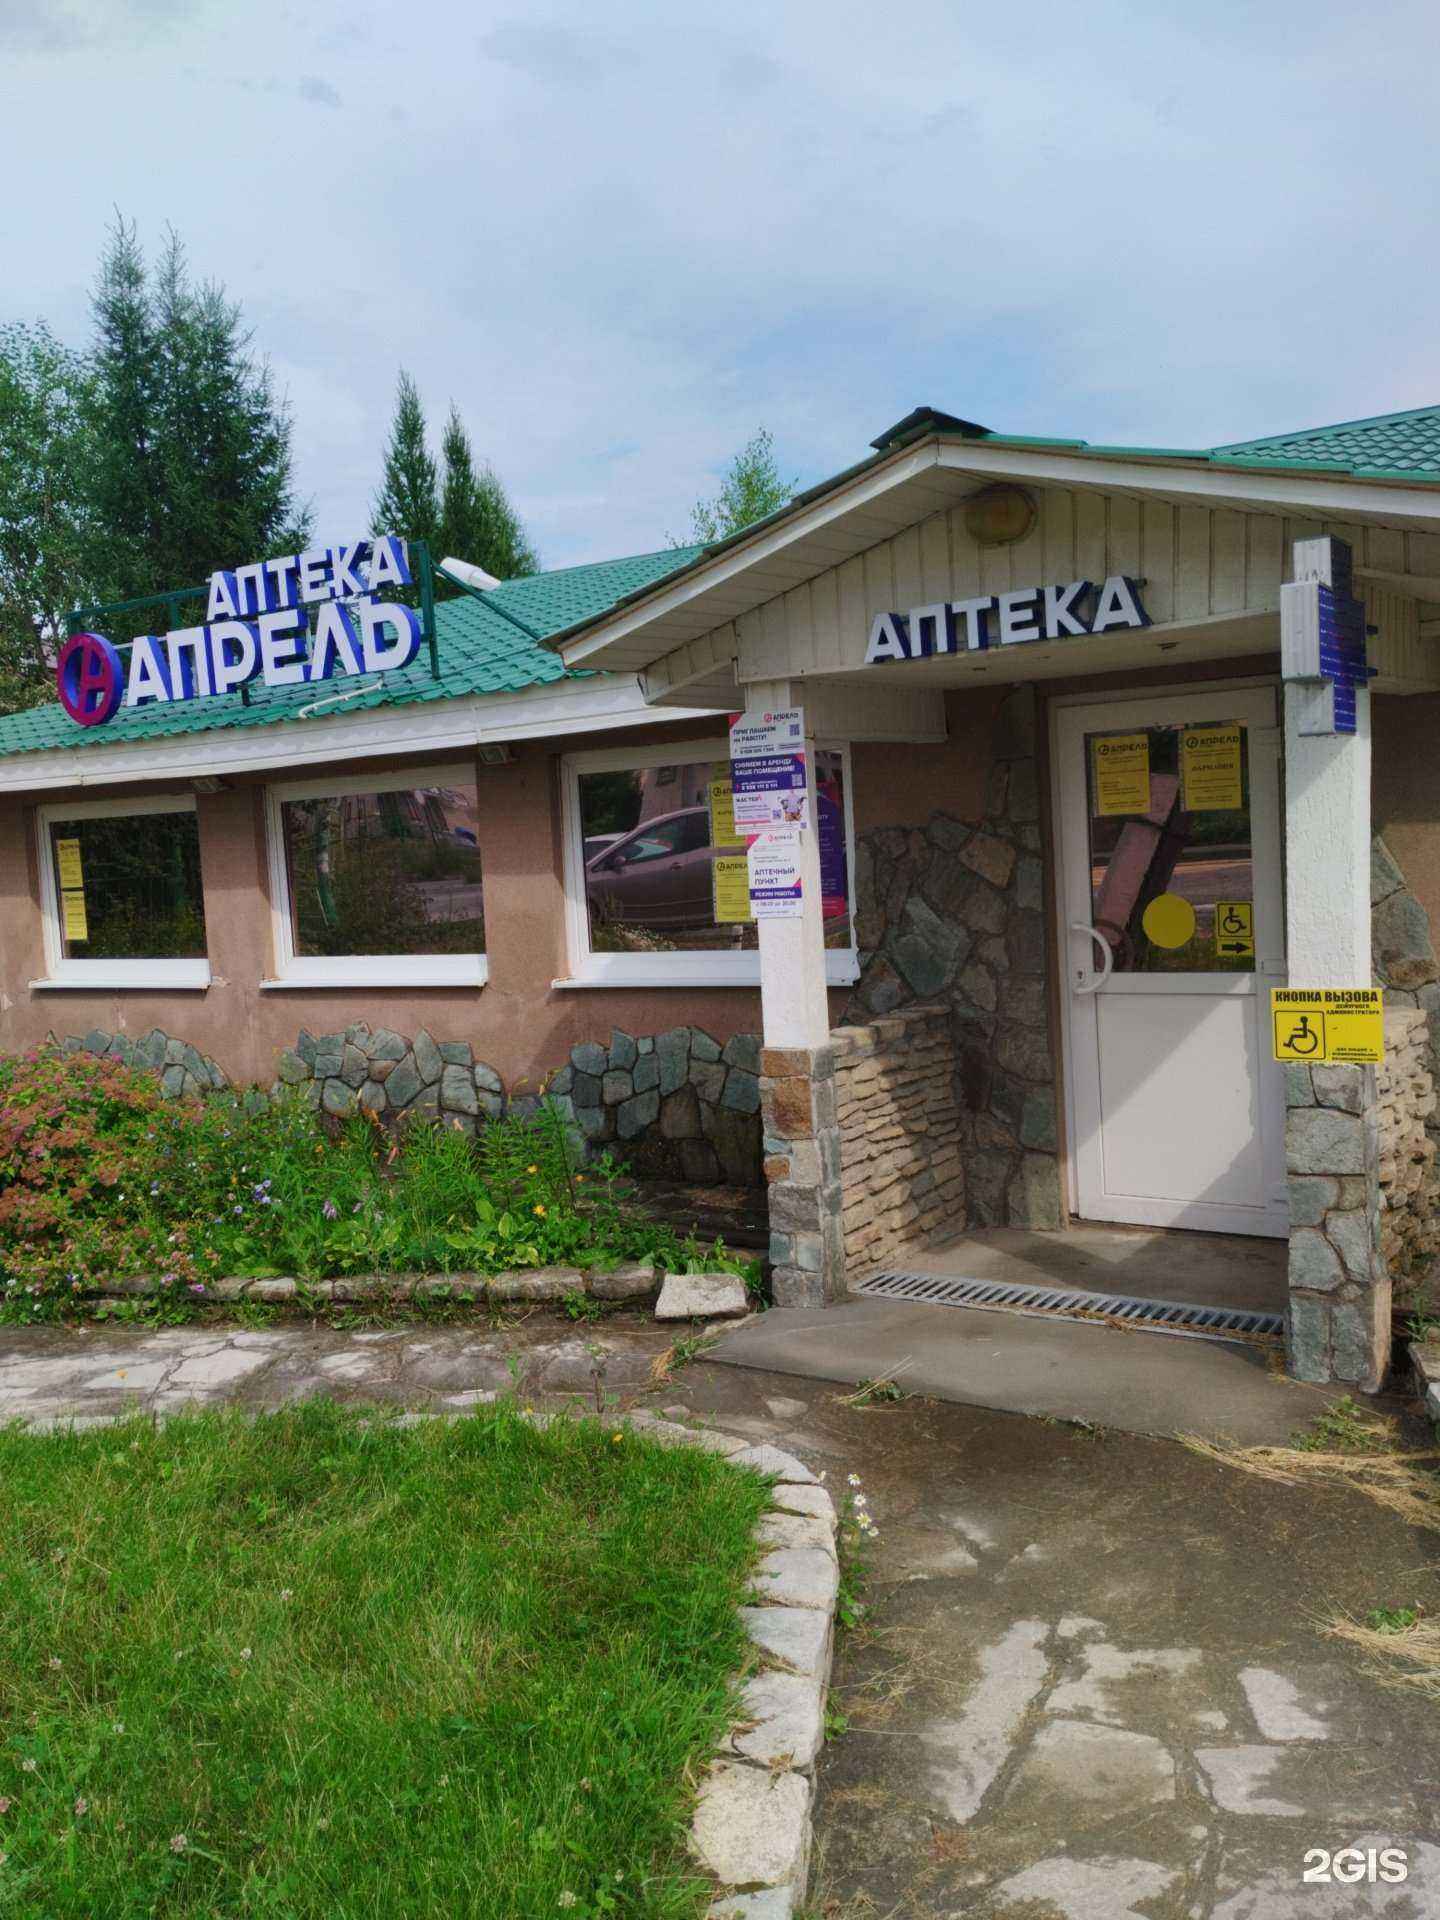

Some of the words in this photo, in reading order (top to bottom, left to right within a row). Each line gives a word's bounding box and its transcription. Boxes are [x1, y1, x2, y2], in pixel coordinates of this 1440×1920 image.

[206, 536, 412, 621] АПТЕКА
[864, 575, 1150, 664] АПТЕКА
[127, 595, 420, 707] АПРЕЛЬ
[754, 867, 796, 876] АПТЕЧНЫЙ
[1275, 991, 1322, 1002] КНОПКА
[1324, 991, 1378, 1003] ВЫЗОВА
